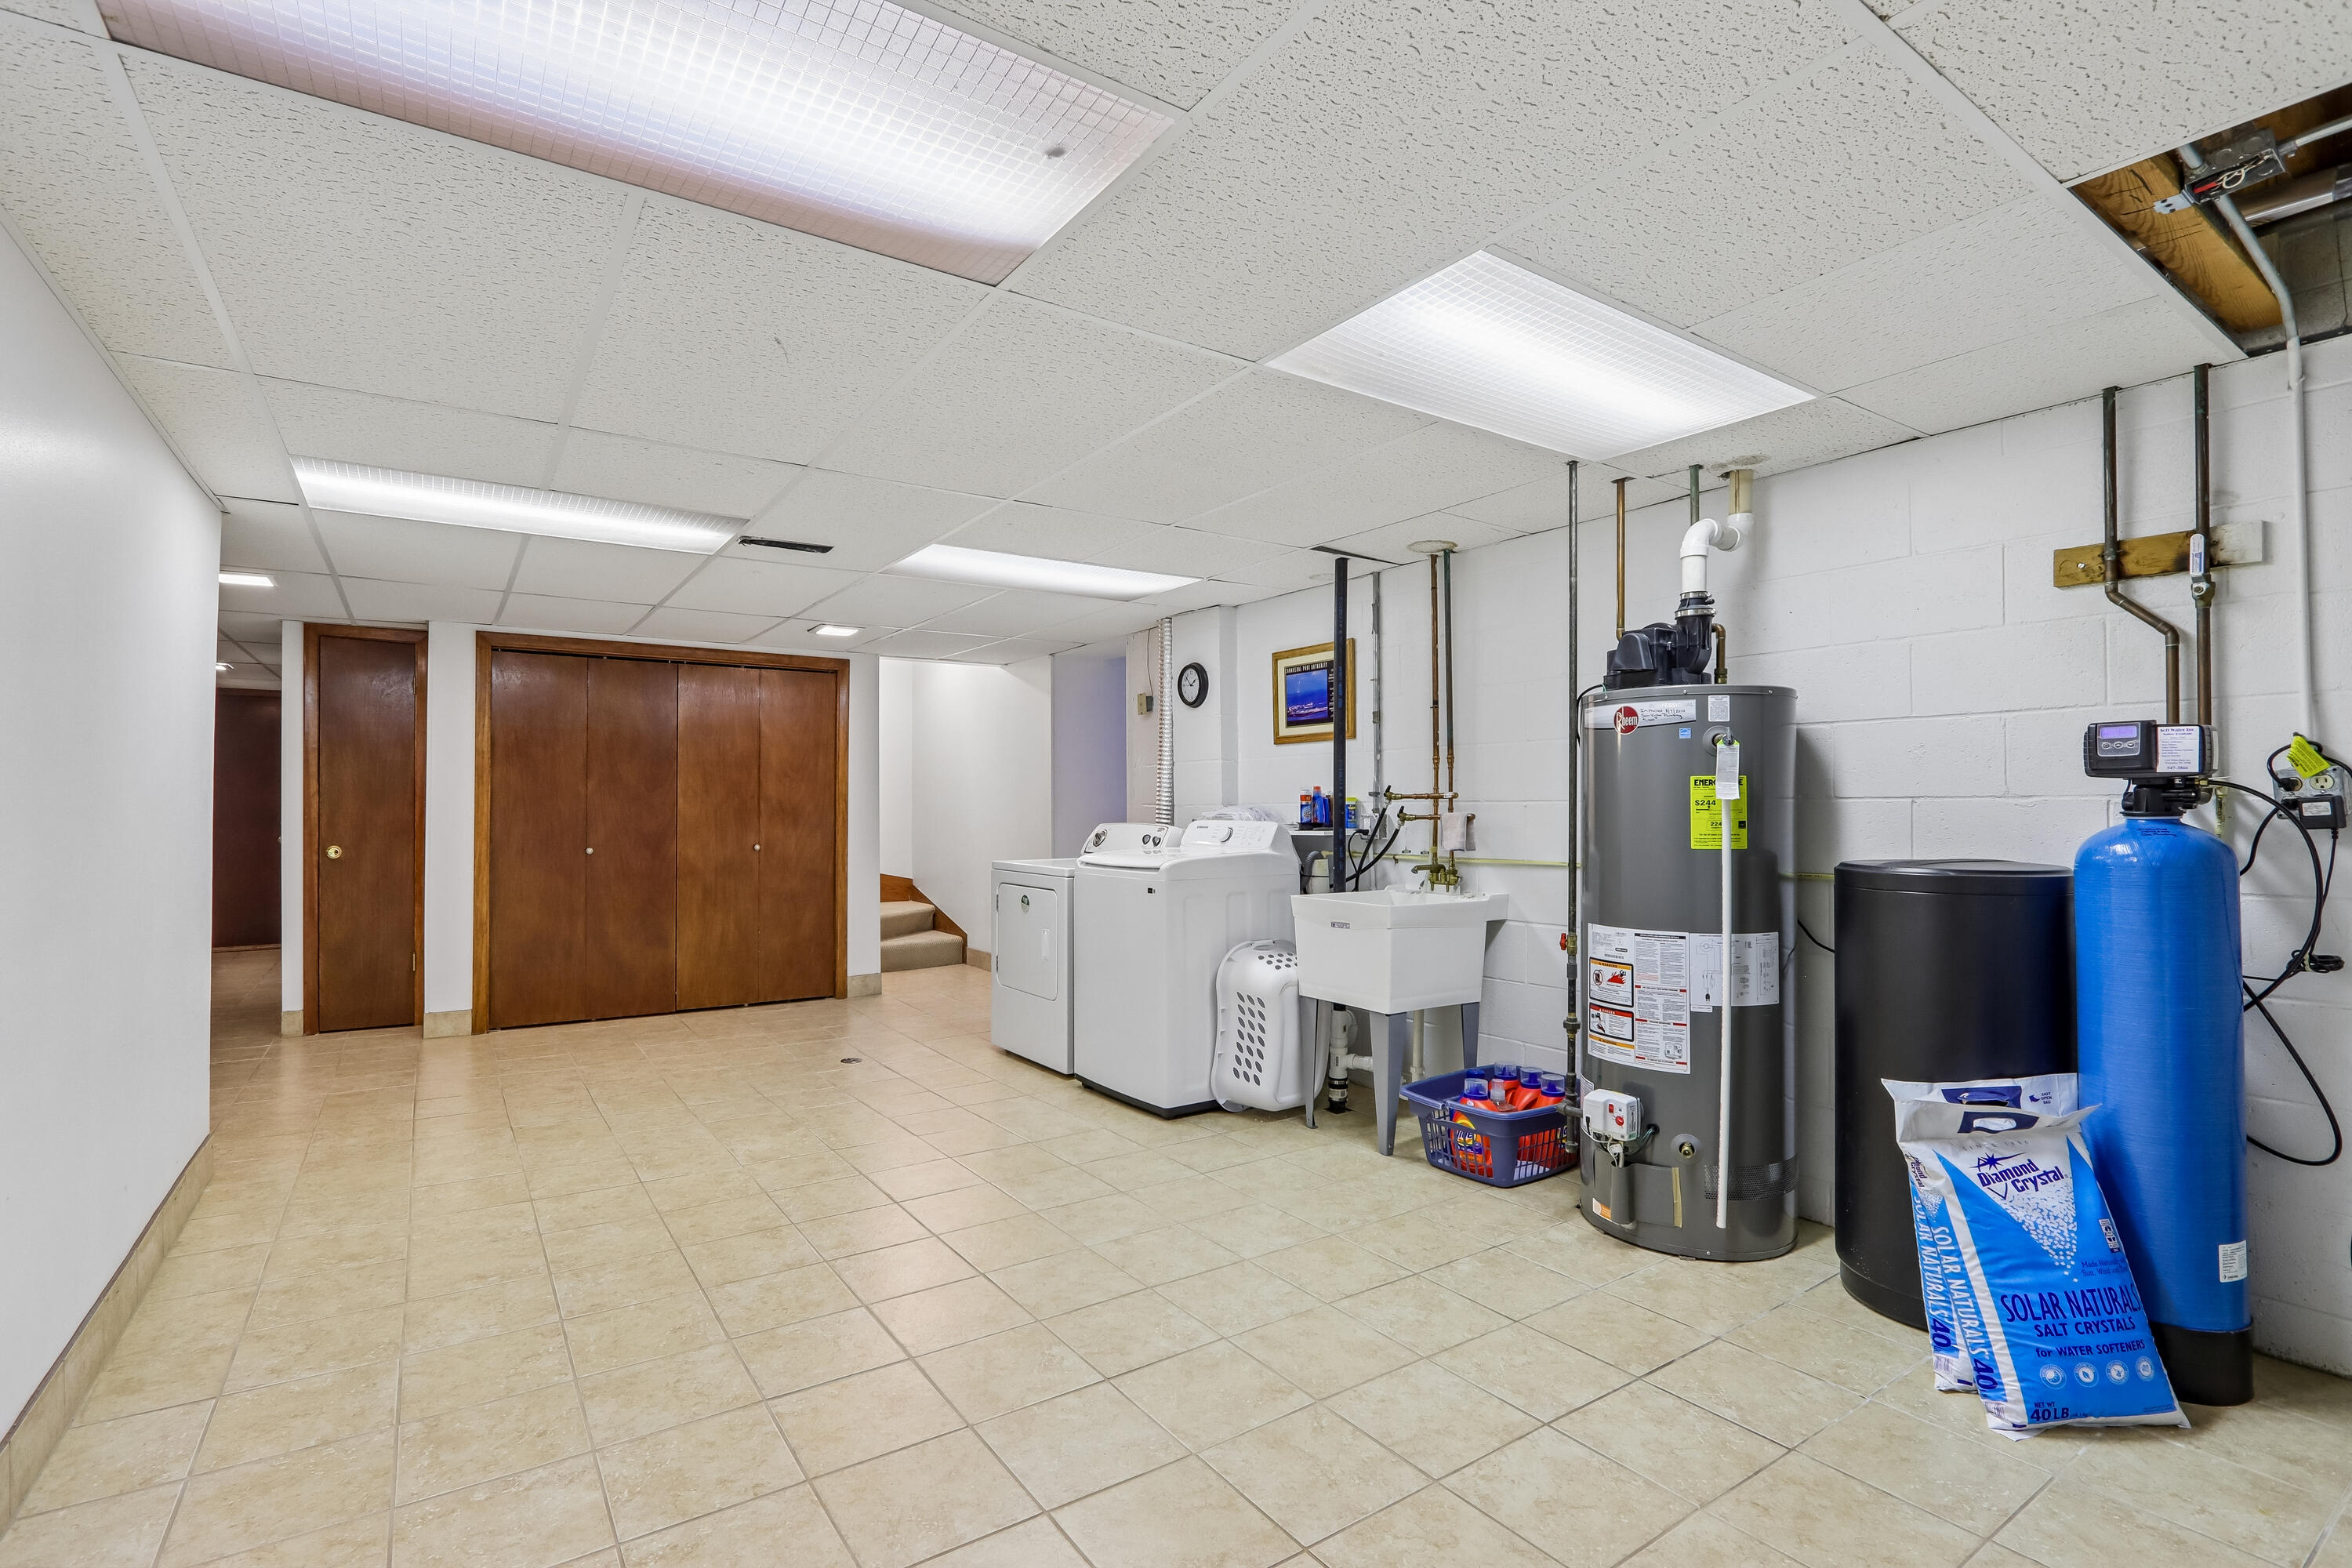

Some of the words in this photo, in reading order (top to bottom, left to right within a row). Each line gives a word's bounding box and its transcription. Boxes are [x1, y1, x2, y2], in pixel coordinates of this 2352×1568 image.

[1616, 706, 1638, 732] Rheem
[1976, 1158, 2040, 1187] Diamond
[2011, 1166, 2065, 1193] Crystal
[1921, 1245, 1946, 1318] NATURALS
[1932, 1225, 1961, 1273] SOLAR
[1947, 1279, 1984, 1356] NATURALS
[1973, 1358, 1998, 1390] 40
[2000, 1290, 2067, 1323] SOLAR
[2063, 1283, 2141, 1319] NATURALS
[1930, 1318, 1951, 1348] 40
[2034, 1323, 2068, 1338] SALT
[2074, 1316, 2136, 1335] CRYSTALS
[2035, 1348, 2053, 1358] for
[2055, 1344, 2094, 1357] WATER
[2096, 1339, 2146, 1355] SOFTENERS
[2031, 1408, 2052, 1421] 40
[2053, 1407, 2070, 1420] LB
